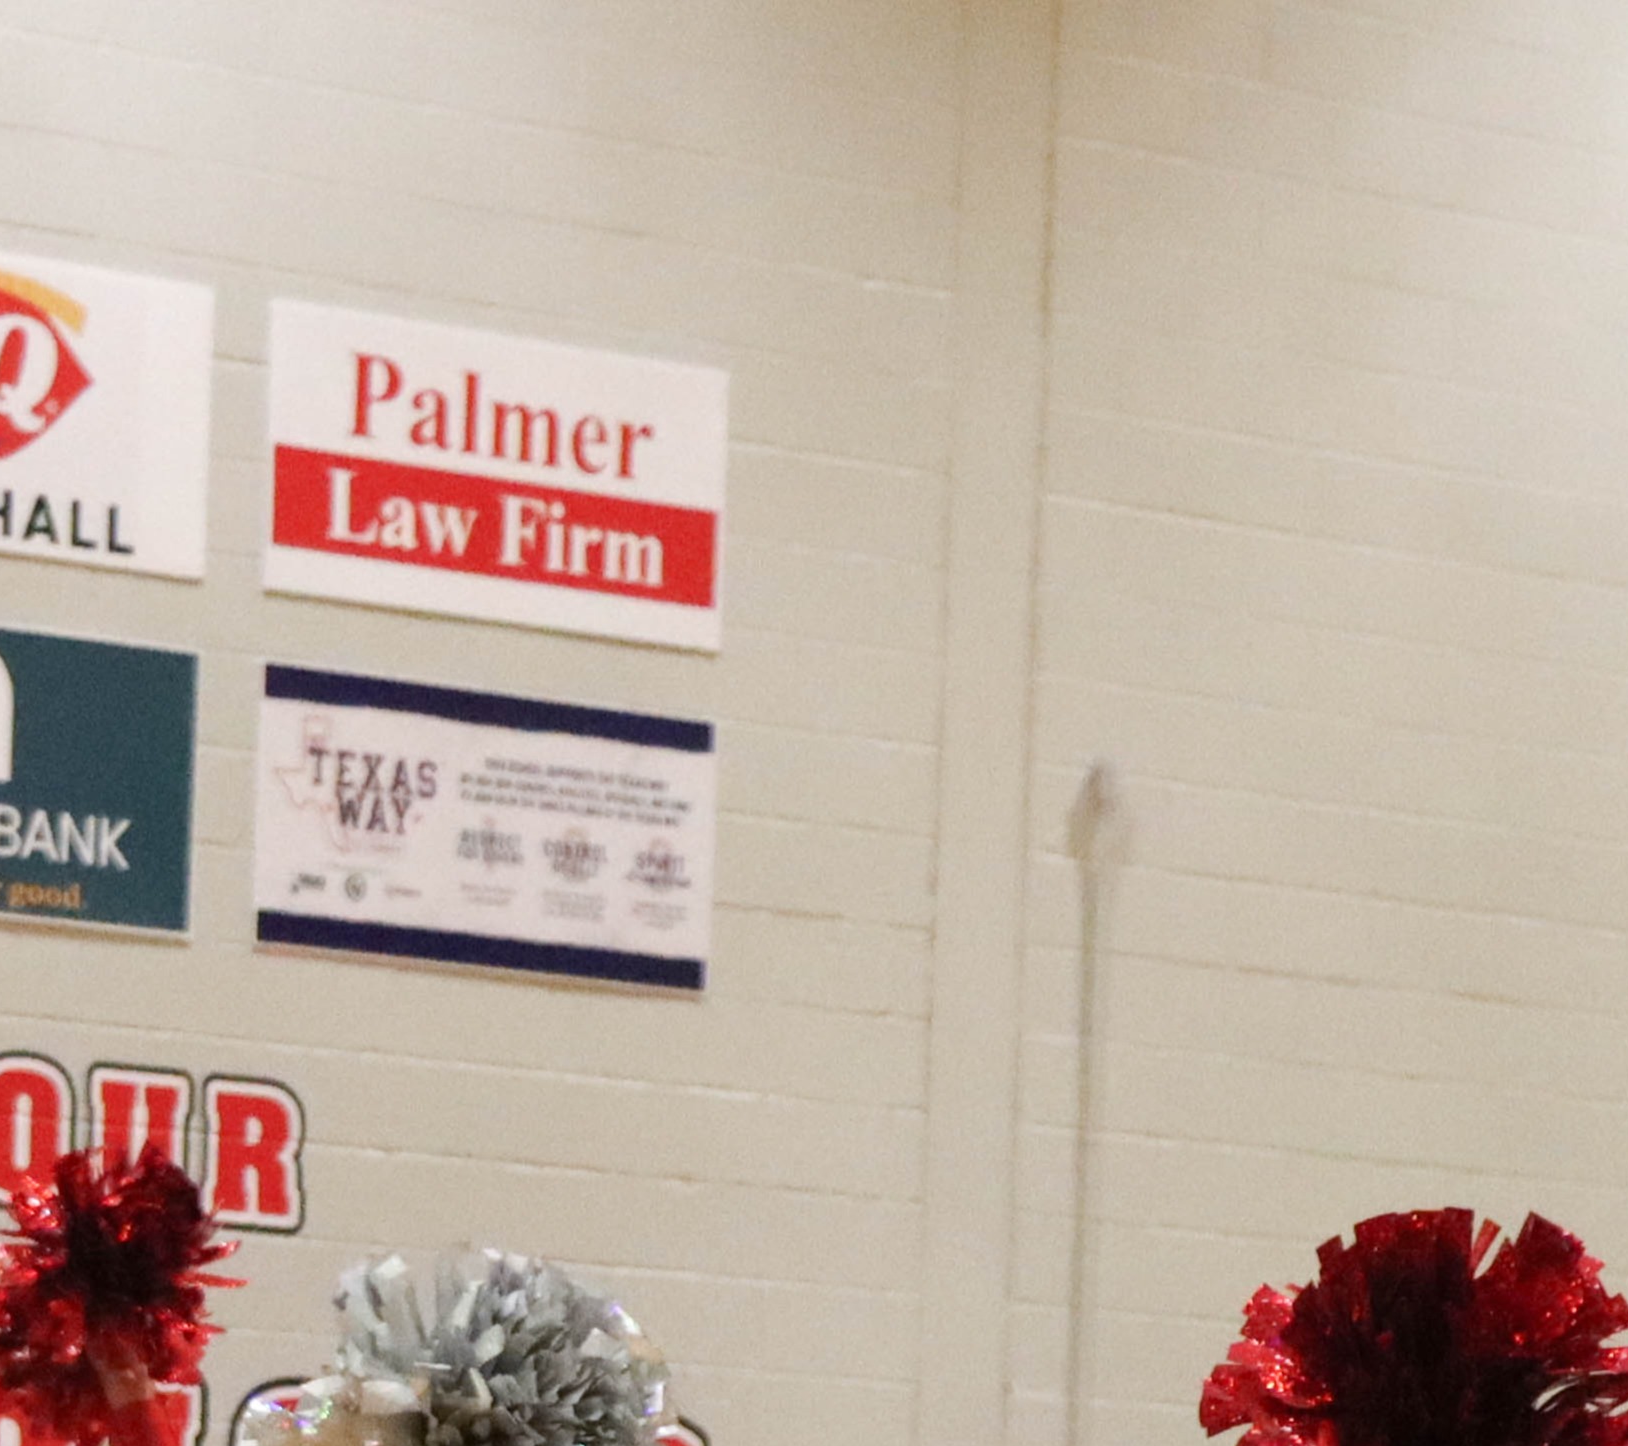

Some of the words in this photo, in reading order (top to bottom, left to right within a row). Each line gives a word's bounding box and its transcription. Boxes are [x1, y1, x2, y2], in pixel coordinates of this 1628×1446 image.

[352, 352, 654, 479] Palmer
[327, 468, 480, 556] Law
[498, 494, 665, 589] Firm
[307, 745, 439, 800] TEXAS
[336, 793, 416, 837] WAY
